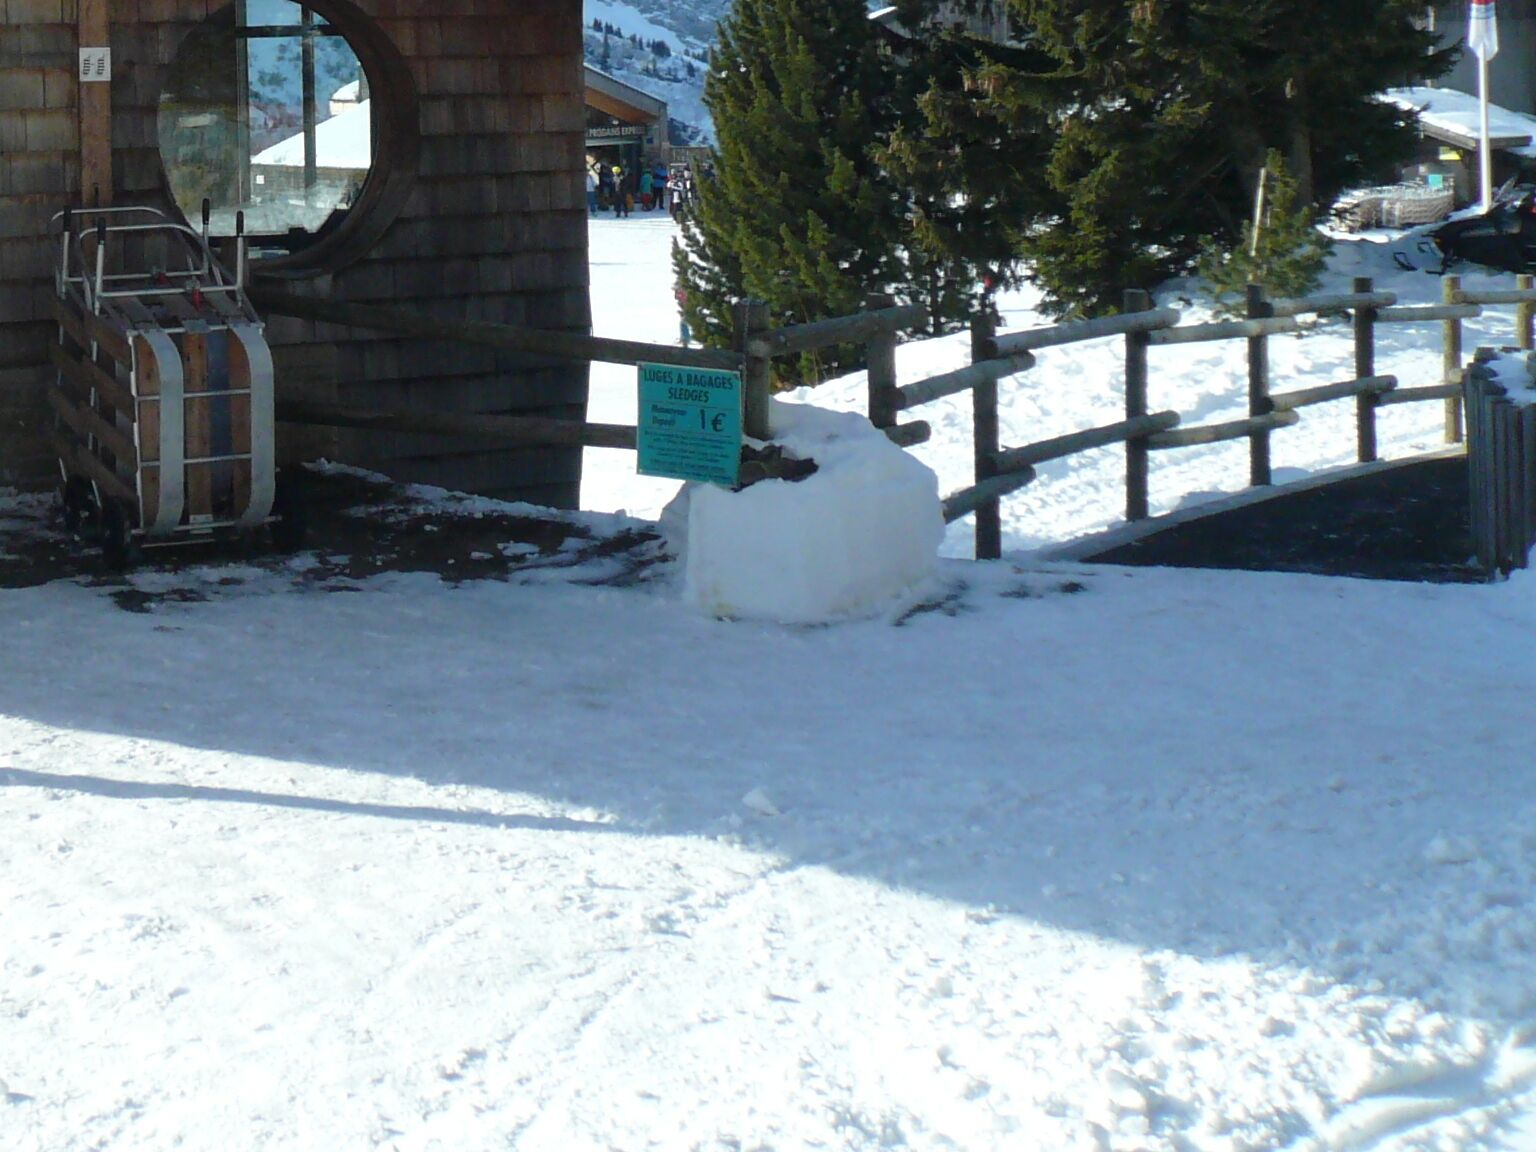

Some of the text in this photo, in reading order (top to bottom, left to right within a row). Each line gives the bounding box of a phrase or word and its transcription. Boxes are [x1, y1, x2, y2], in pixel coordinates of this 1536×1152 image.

[643, 368, 673, 384] LUGES
[686, 373, 734, 390] BAGAGES
[668, 387, 709, 403] SLEDGES
[700, 409, 706, 429] 1
[711, 412, 726, 432] €
